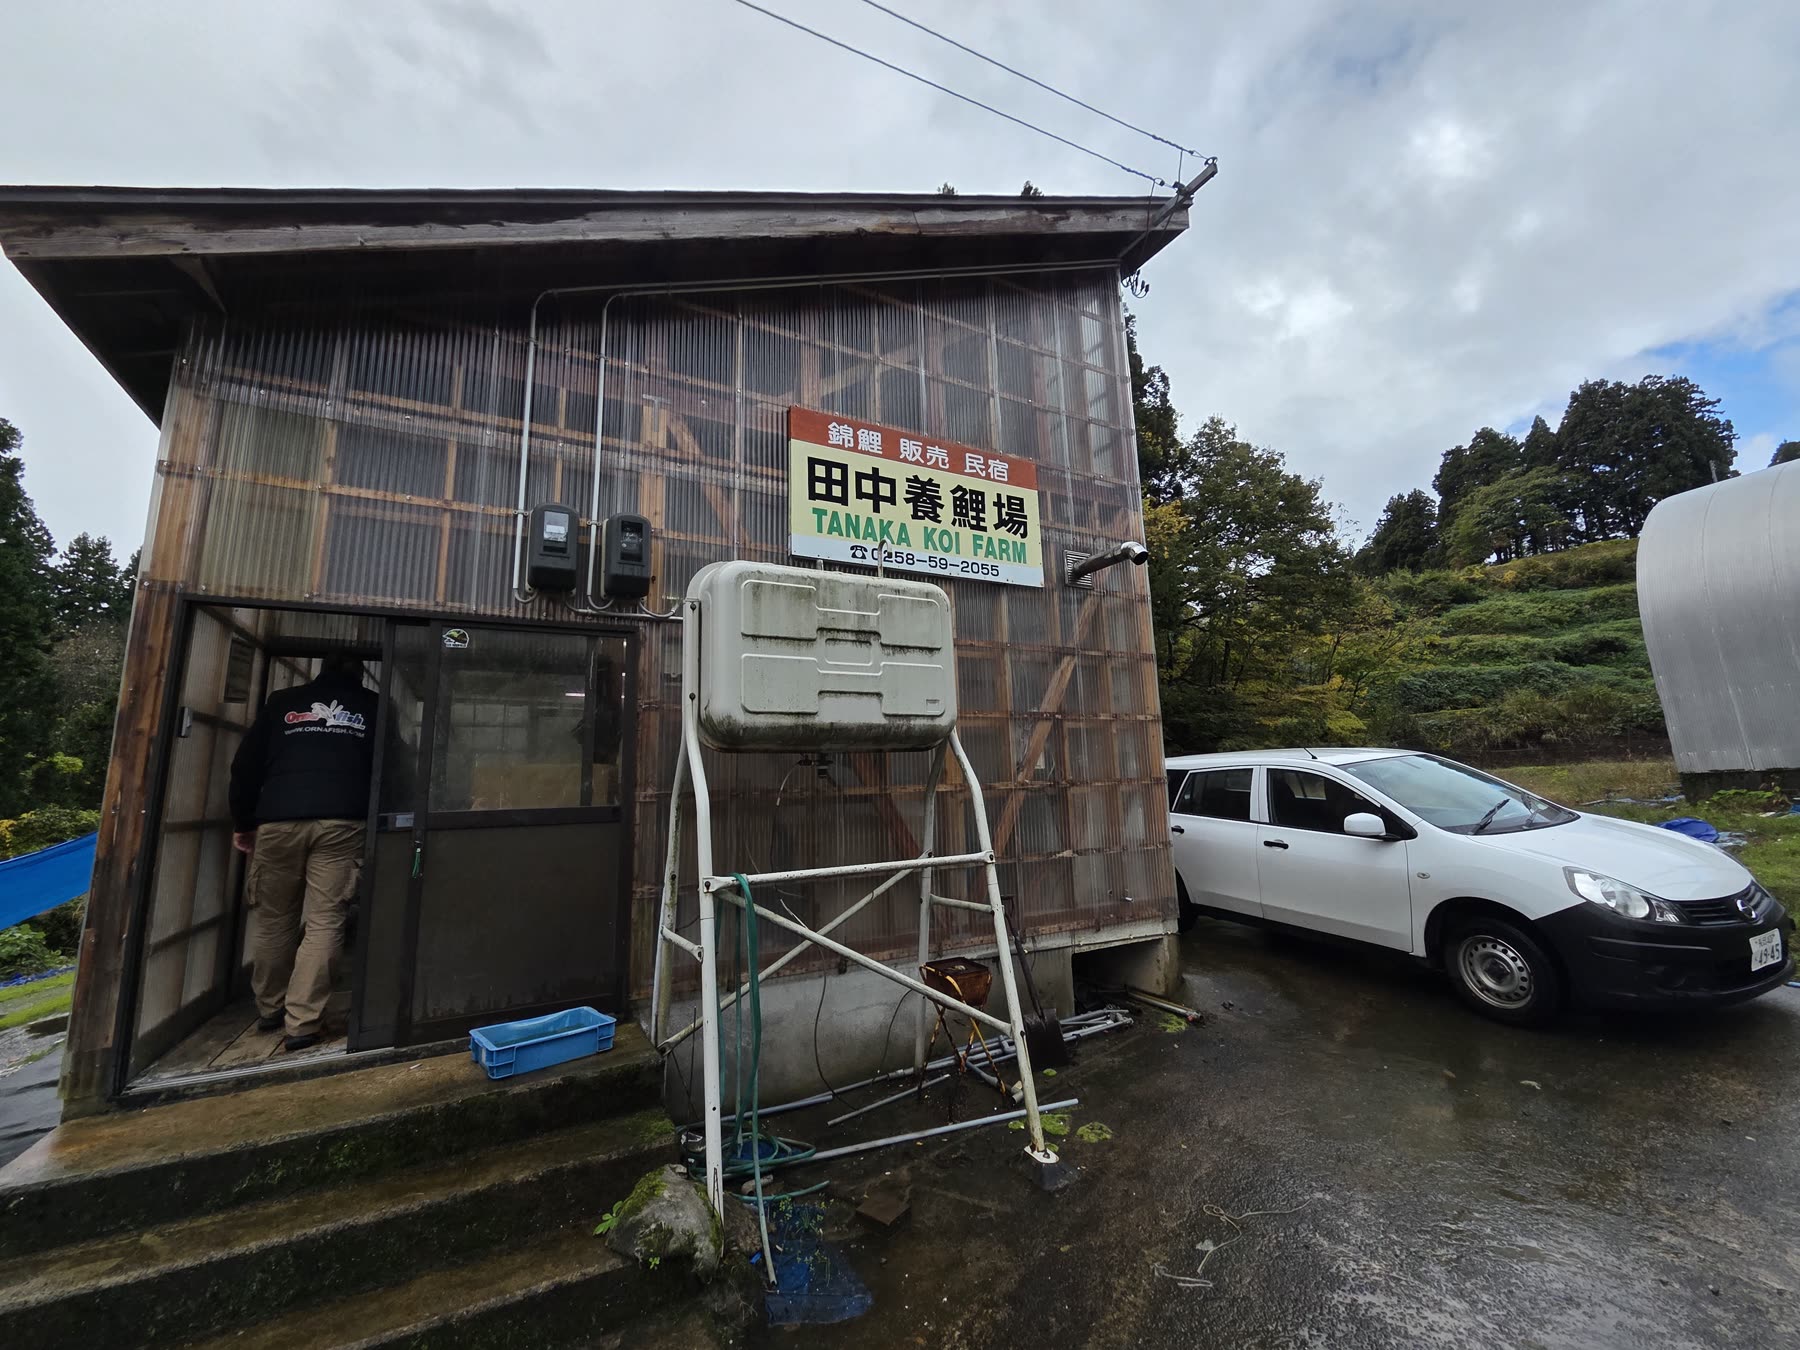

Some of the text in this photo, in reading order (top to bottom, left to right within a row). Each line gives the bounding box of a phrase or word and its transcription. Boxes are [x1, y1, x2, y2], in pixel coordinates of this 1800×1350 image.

[827, 421, 1009, 482] 錦鯉 販売 民宿
[807, 456, 1028, 539] 田中養鯉場
[812, 507, 1027, 564] TANAKA KOI FARM
